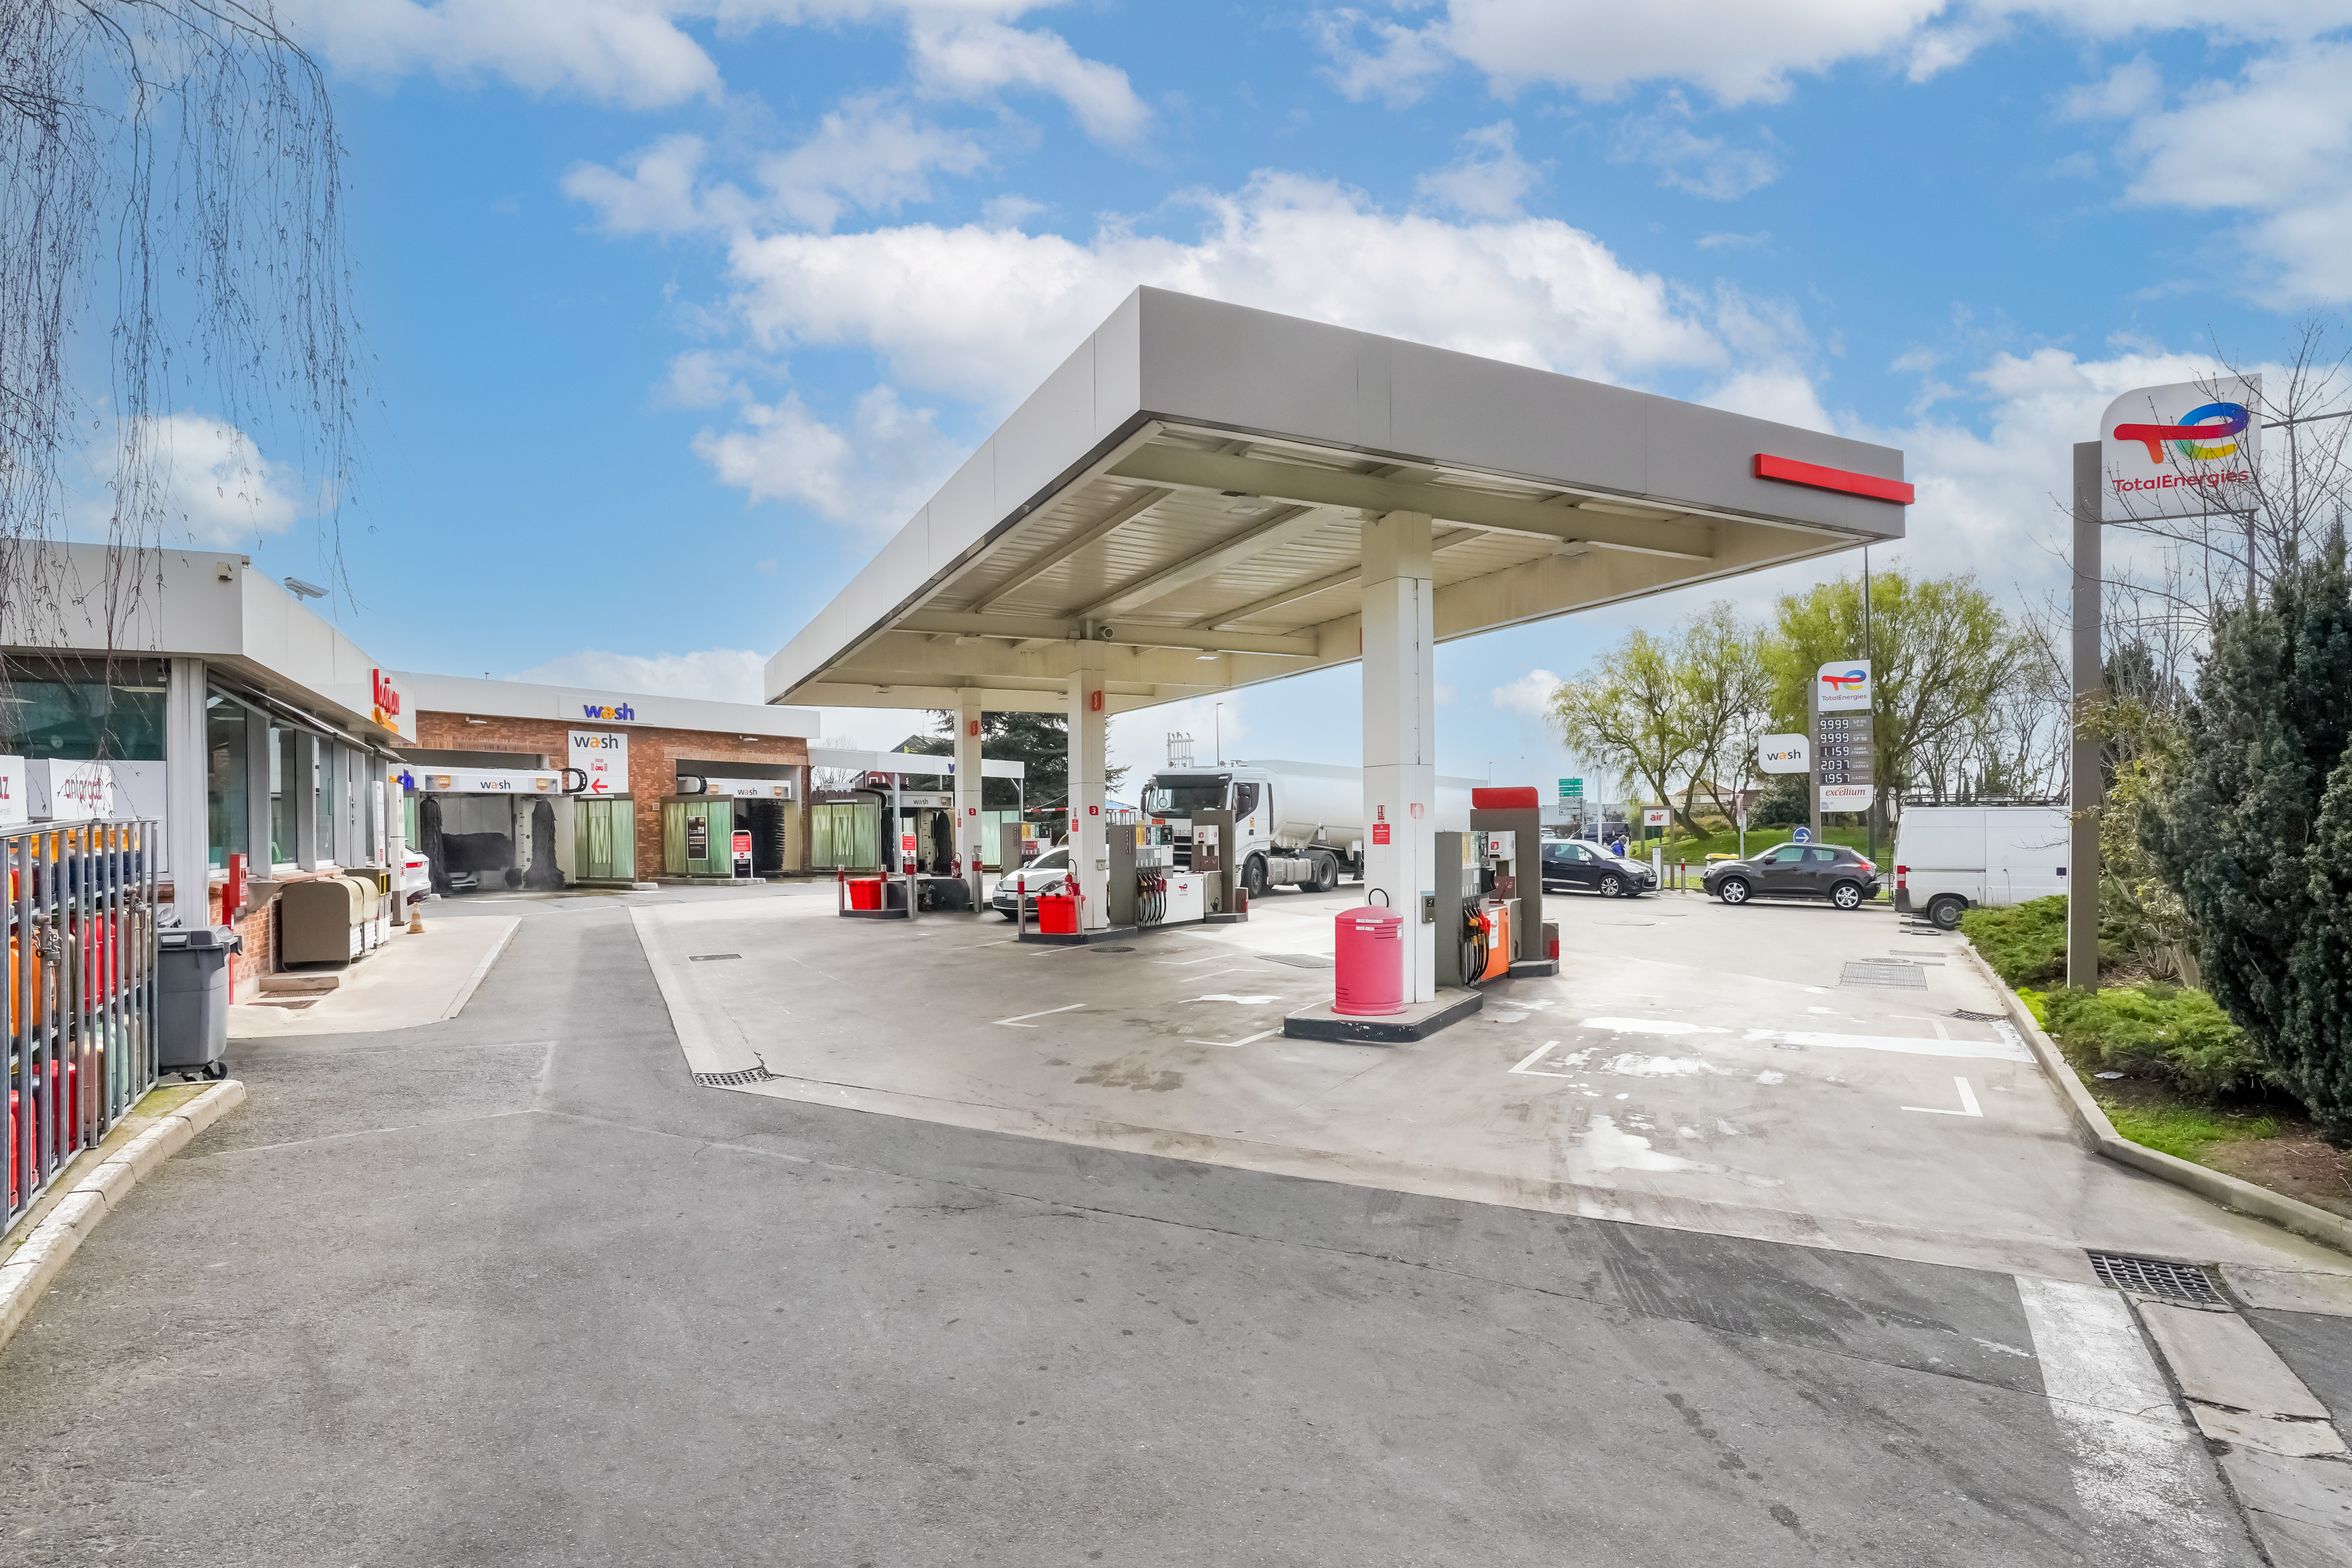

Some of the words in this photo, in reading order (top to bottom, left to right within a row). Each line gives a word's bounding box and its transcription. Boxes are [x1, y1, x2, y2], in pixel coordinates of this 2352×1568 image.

[2112, 469, 2249, 492] TotalEnergies
[583, 702, 634, 720] wash
[574, 733, 619, 750] wash
[1766, 749, 1801, 760] wash
[480, 779, 511, 789] wash
[65, 774, 103, 808] antargaz
[737, 787, 757, 796] wash
[1825, 787, 1866, 797] excellium
[1650, 812, 1664, 821] air
